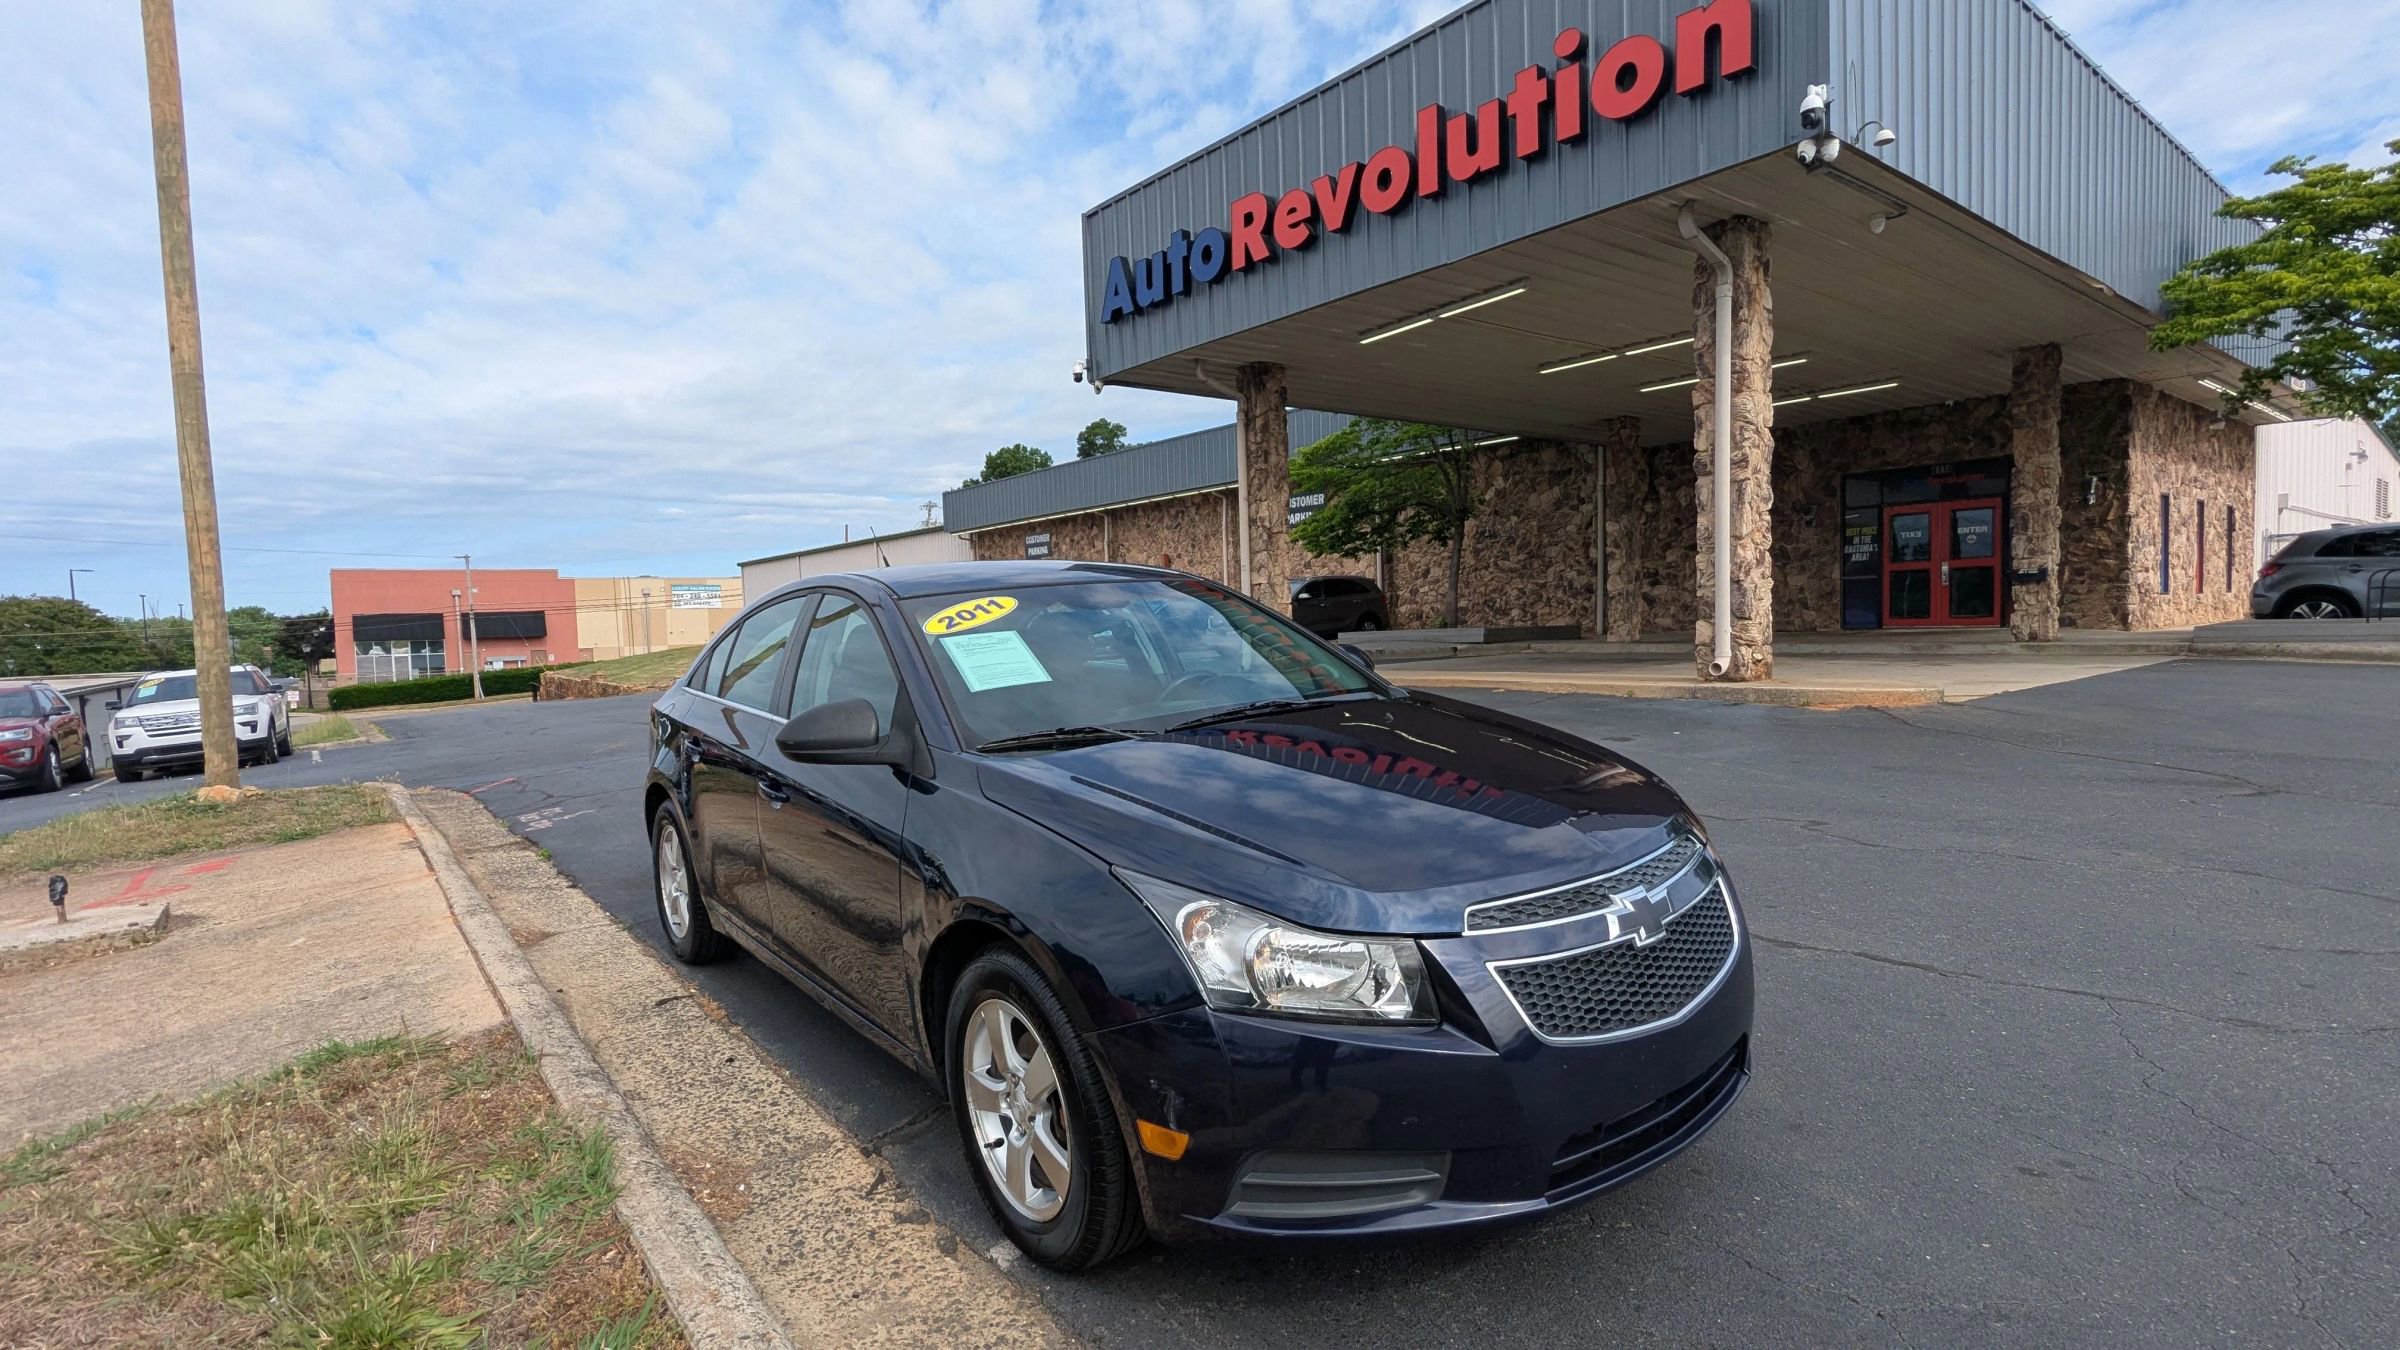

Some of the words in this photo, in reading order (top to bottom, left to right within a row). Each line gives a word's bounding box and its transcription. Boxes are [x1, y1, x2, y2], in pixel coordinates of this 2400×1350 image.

[1101, 0, 1758, 324] AutoRevolution
[1957, 525, 1988, 534] ENTER
[1025, 534, 1050, 544] CUSTOMER
[1028, 546, 1048, 556] PARKING
[937, 599, 1008, 631] 2011
